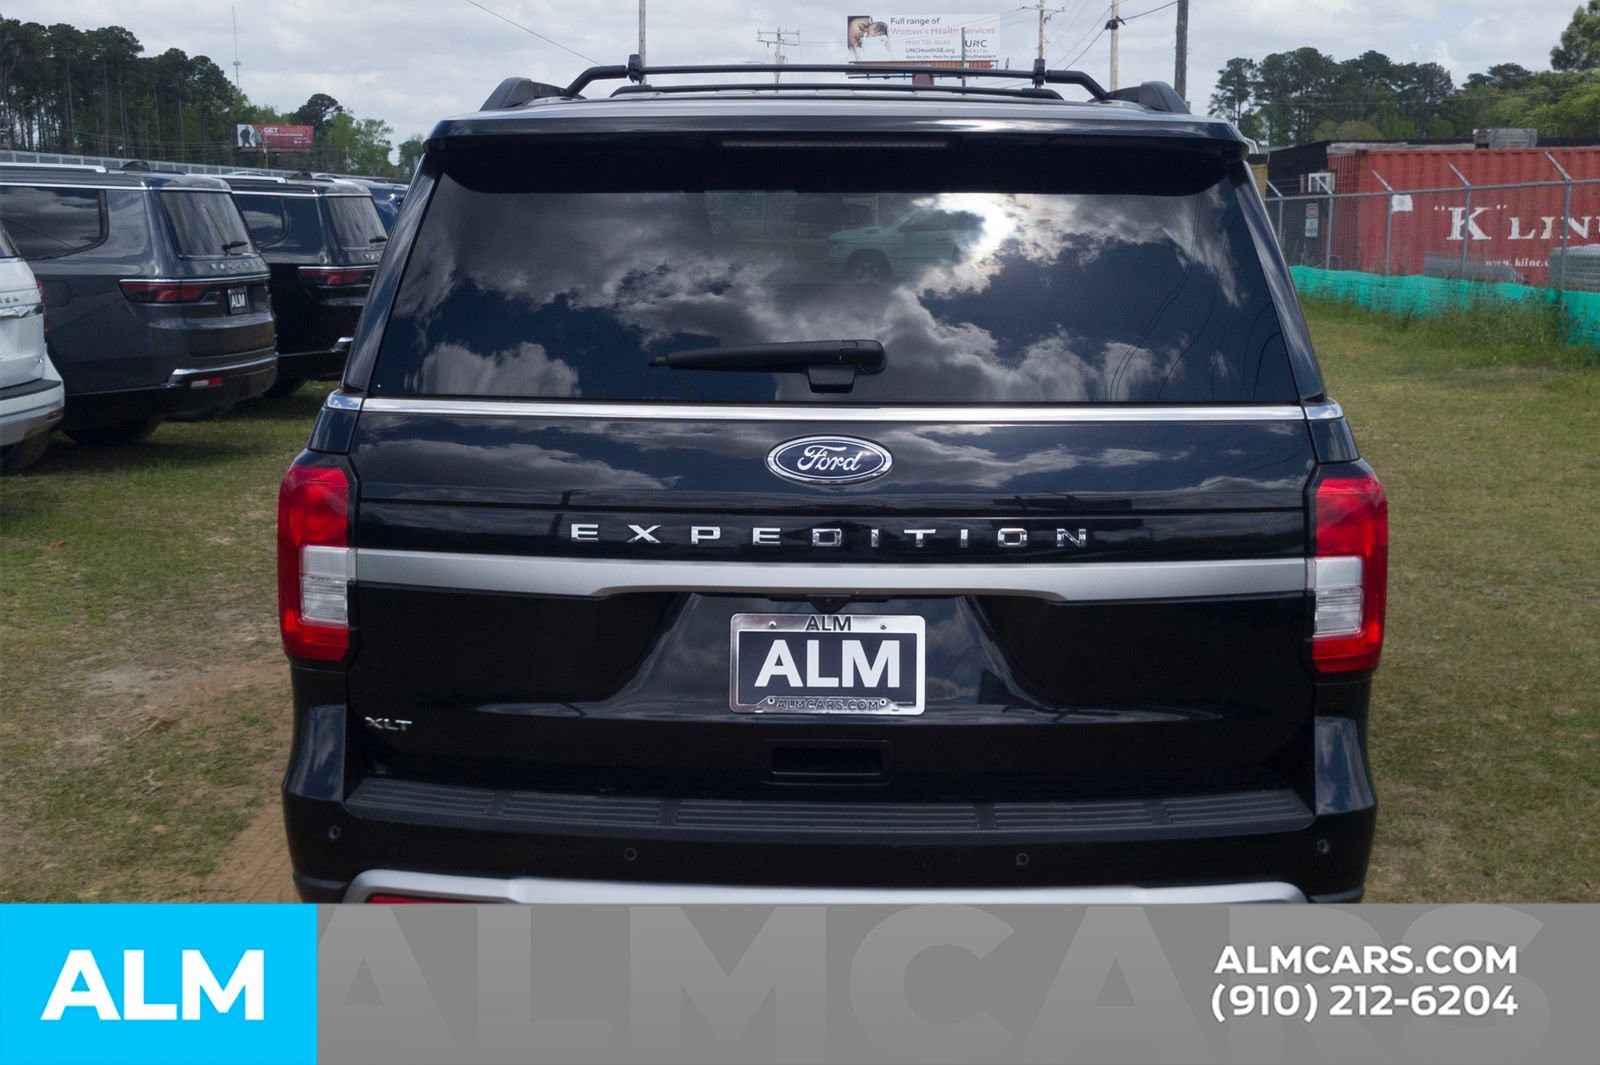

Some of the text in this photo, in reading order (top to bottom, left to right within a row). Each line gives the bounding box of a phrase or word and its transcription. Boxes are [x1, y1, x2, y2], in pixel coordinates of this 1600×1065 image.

[890, 17, 940, 26] Full range of
[890, 27, 929, 35] Women's
[931, 27, 959, 35] Health
[965, 39, 987, 48] UNC
[1507, 216, 1600, 241] LIN
[231, 293, 246, 308] ALM
[797, 444, 863, 472] Ford
[570, 523, 1087, 548] EXPEDITION
[805, 615, 852, 632] ALM
[754, 639, 900, 688] ALM
[776, 699, 880, 711] ALMCARS.COM
[364, 716, 413, 731] XLT
